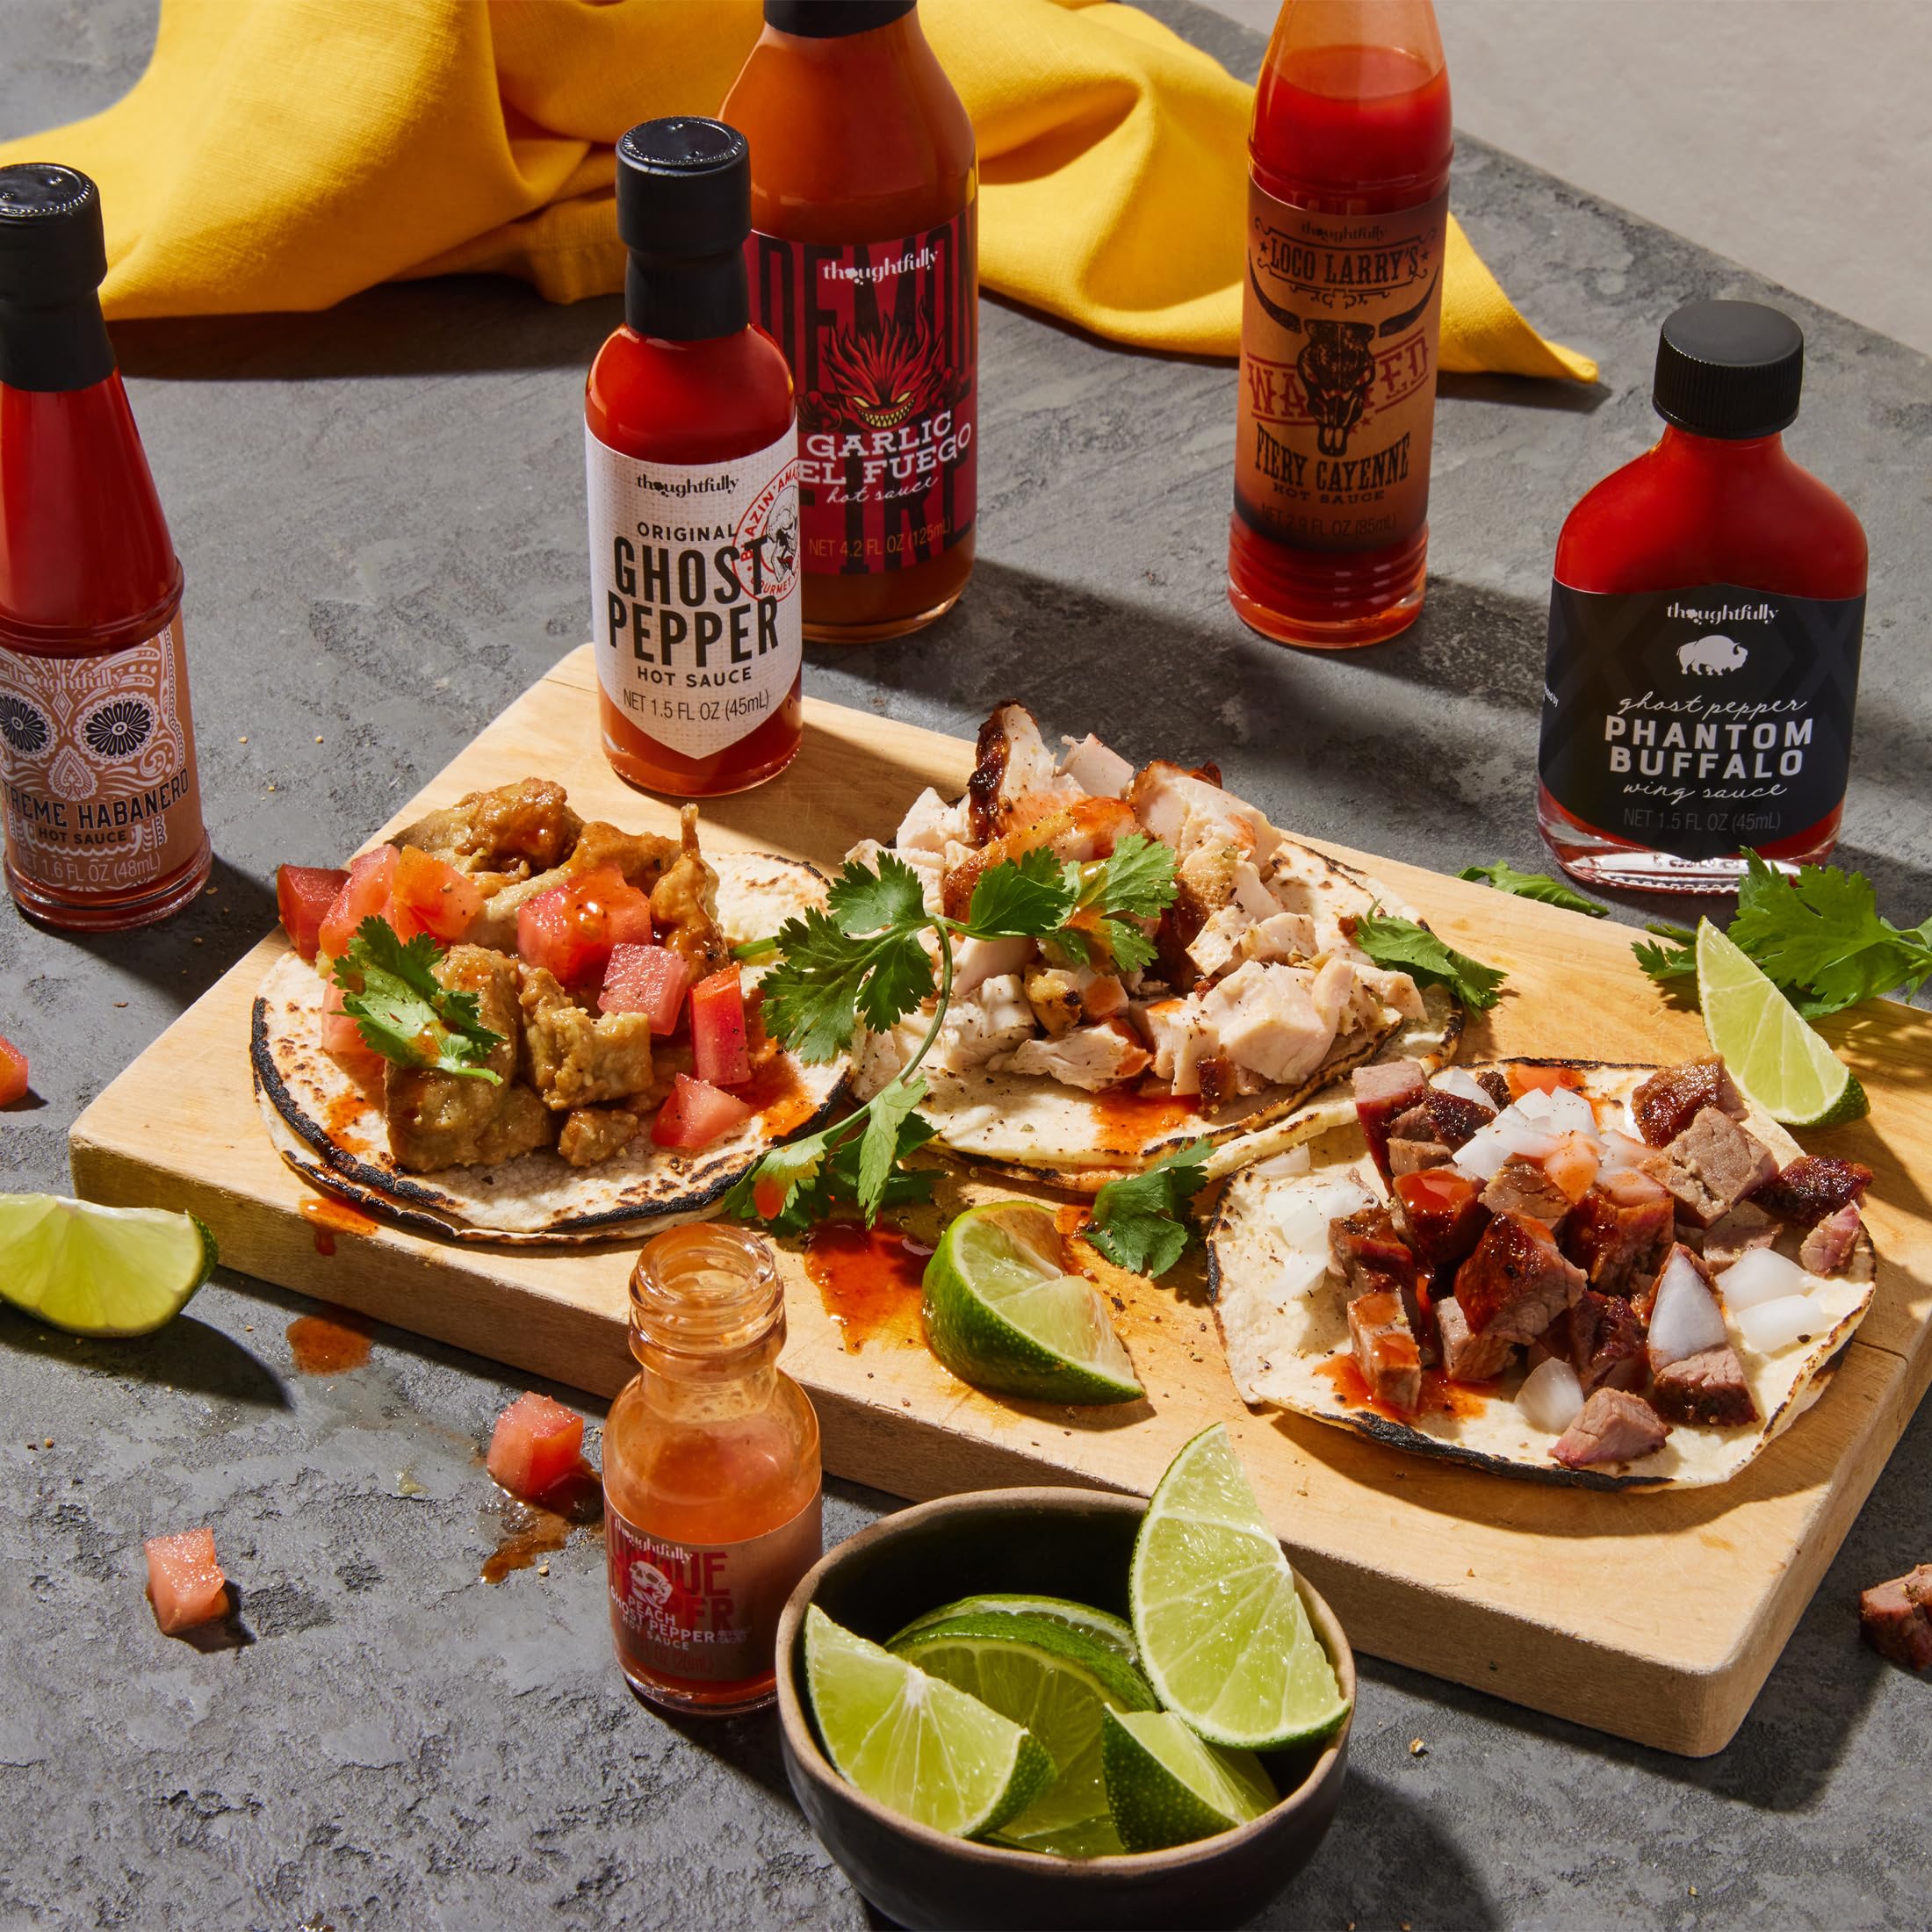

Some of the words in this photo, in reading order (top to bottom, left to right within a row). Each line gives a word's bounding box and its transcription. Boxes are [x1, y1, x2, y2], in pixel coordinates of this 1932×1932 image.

[823, 247, 939, 286] thoughtfully
[1270, 237, 1316, 281] LOCO
[1323, 244, 1420, 285] LARRY'S
[1247, 336, 1429, 417] WAED
[806, 409, 952, 459] GARLIC
[798, 460, 847, 484] EL
[862, 422, 971, 484] FUEGO
[1255, 422, 1308, 488] FIERY
[1316, 431, 1411, 494] CAYENNE
[637, 473, 739, 498] thoughtfully
[826, 483, 870, 503] hot
[875, 475, 939, 501] sauce
[1272, 482, 1310, 501] HOT
[1320, 490, 1385, 505] SAUCE
[637, 521, 739, 542] ORIGINAL
[809, 538, 836, 558] NET
[840, 540, 862, 558] 4.2
[867, 538, 883, 556] FL
[887, 533, 905, 553] OZ
[907, 517, 952, 551] (125mL)
[1311, 517, 1327, 537] FL
[1331, 519, 1351, 537] OZ
[613, 534, 768, 608] GHOST
[607, 589, 780, 668] PEPPER
[1667, 602, 1779, 626] thoughtfully
[637, 666, 676, 687] HOT
[687, 666, 753, 688] SAUCE
[623, 688, 647, 713] NET
[651, 696, 674, 719] 1.5
[678, 702, 696, 721] FL
[700, 702, 721, 722] OZ
[724, 688, 771, 722] (45mL)
[1618, 691, 1704, 717] ghost
[1701, 696, 1807, 722] pepper
[1604, 715, 1813, 750] PHANTOM
[1610, 746, 1804, 779] BUFFALO
[79, 768, 190, 830] HABANERO
[1623, 781, 1695, 806] wing
[1702, 783, 1788, 800] sauce
[38, 827, 68, 844] HOT
[74, 829, 127, 846] SAUCE
[1624, 807, 1653, 829] NET
[1658, 811, 1681, 831] 1.5
[1684, 812, 1703, 832] FL
[1707, 812, 1728, 833] OZ
[1732, 811, 1781, 833] (45mL)
[42, 859, 63, 880] 1.6
[67, 864, 84, 883] FL
[89, 864, 111, 883] OZ
[113, 852, 162, 885] (48mL)
[610, 1585, 645, 1626] GHOST
[649, 1619, 716, 1645] PEPPER
[628, 1594, 676, 1626] PEACH
[622, 1614, 641, 1633] HOT
[646, 1630, 690, 1651] SAUCE
